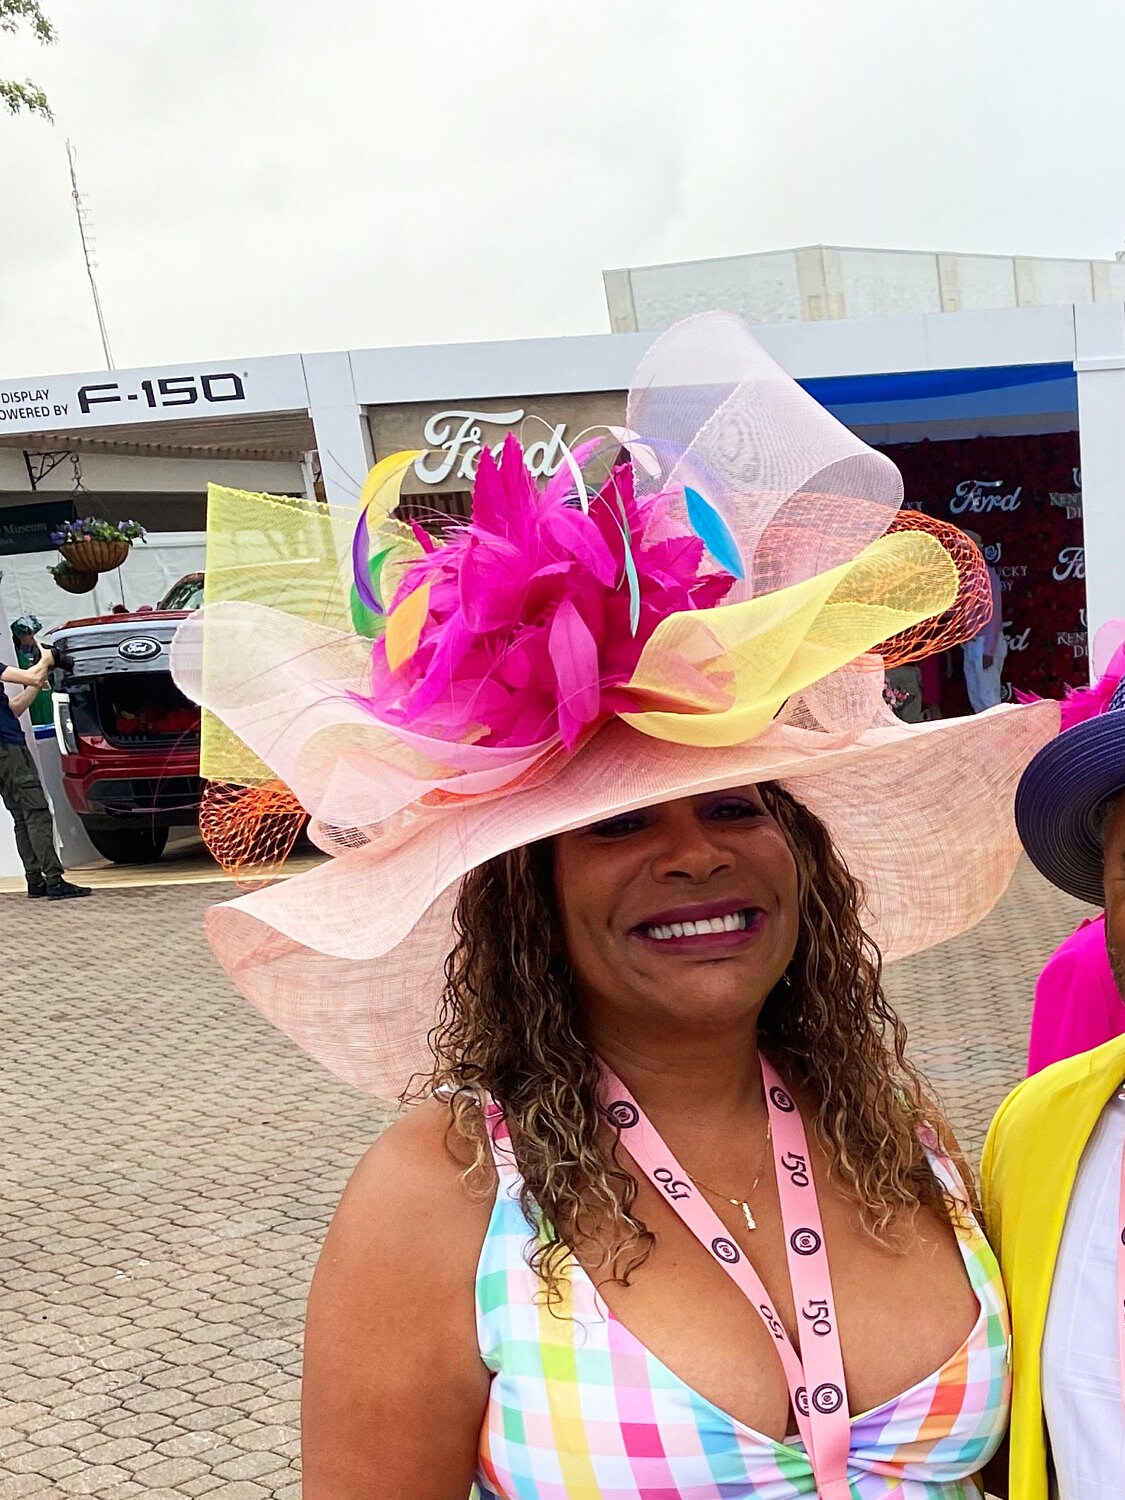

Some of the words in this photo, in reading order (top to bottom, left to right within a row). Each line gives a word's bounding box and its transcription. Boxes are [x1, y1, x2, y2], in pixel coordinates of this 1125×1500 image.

[1, 389, 49, 403] DISPLAY
[77, 373, 245, 414] F-150
[0, 406, 50, 420] OWERED
[53, 404, 68, 416] BY
[950, 480, 1022, 514] Ford
[127, 642, 147, 653] Ford
[653, 1167, 692, 1201] 150
[781, 1151, 809, 1188] 150
[759, 1303, 785, 1341] 150
[802, 1298, 832, 1336] 150
